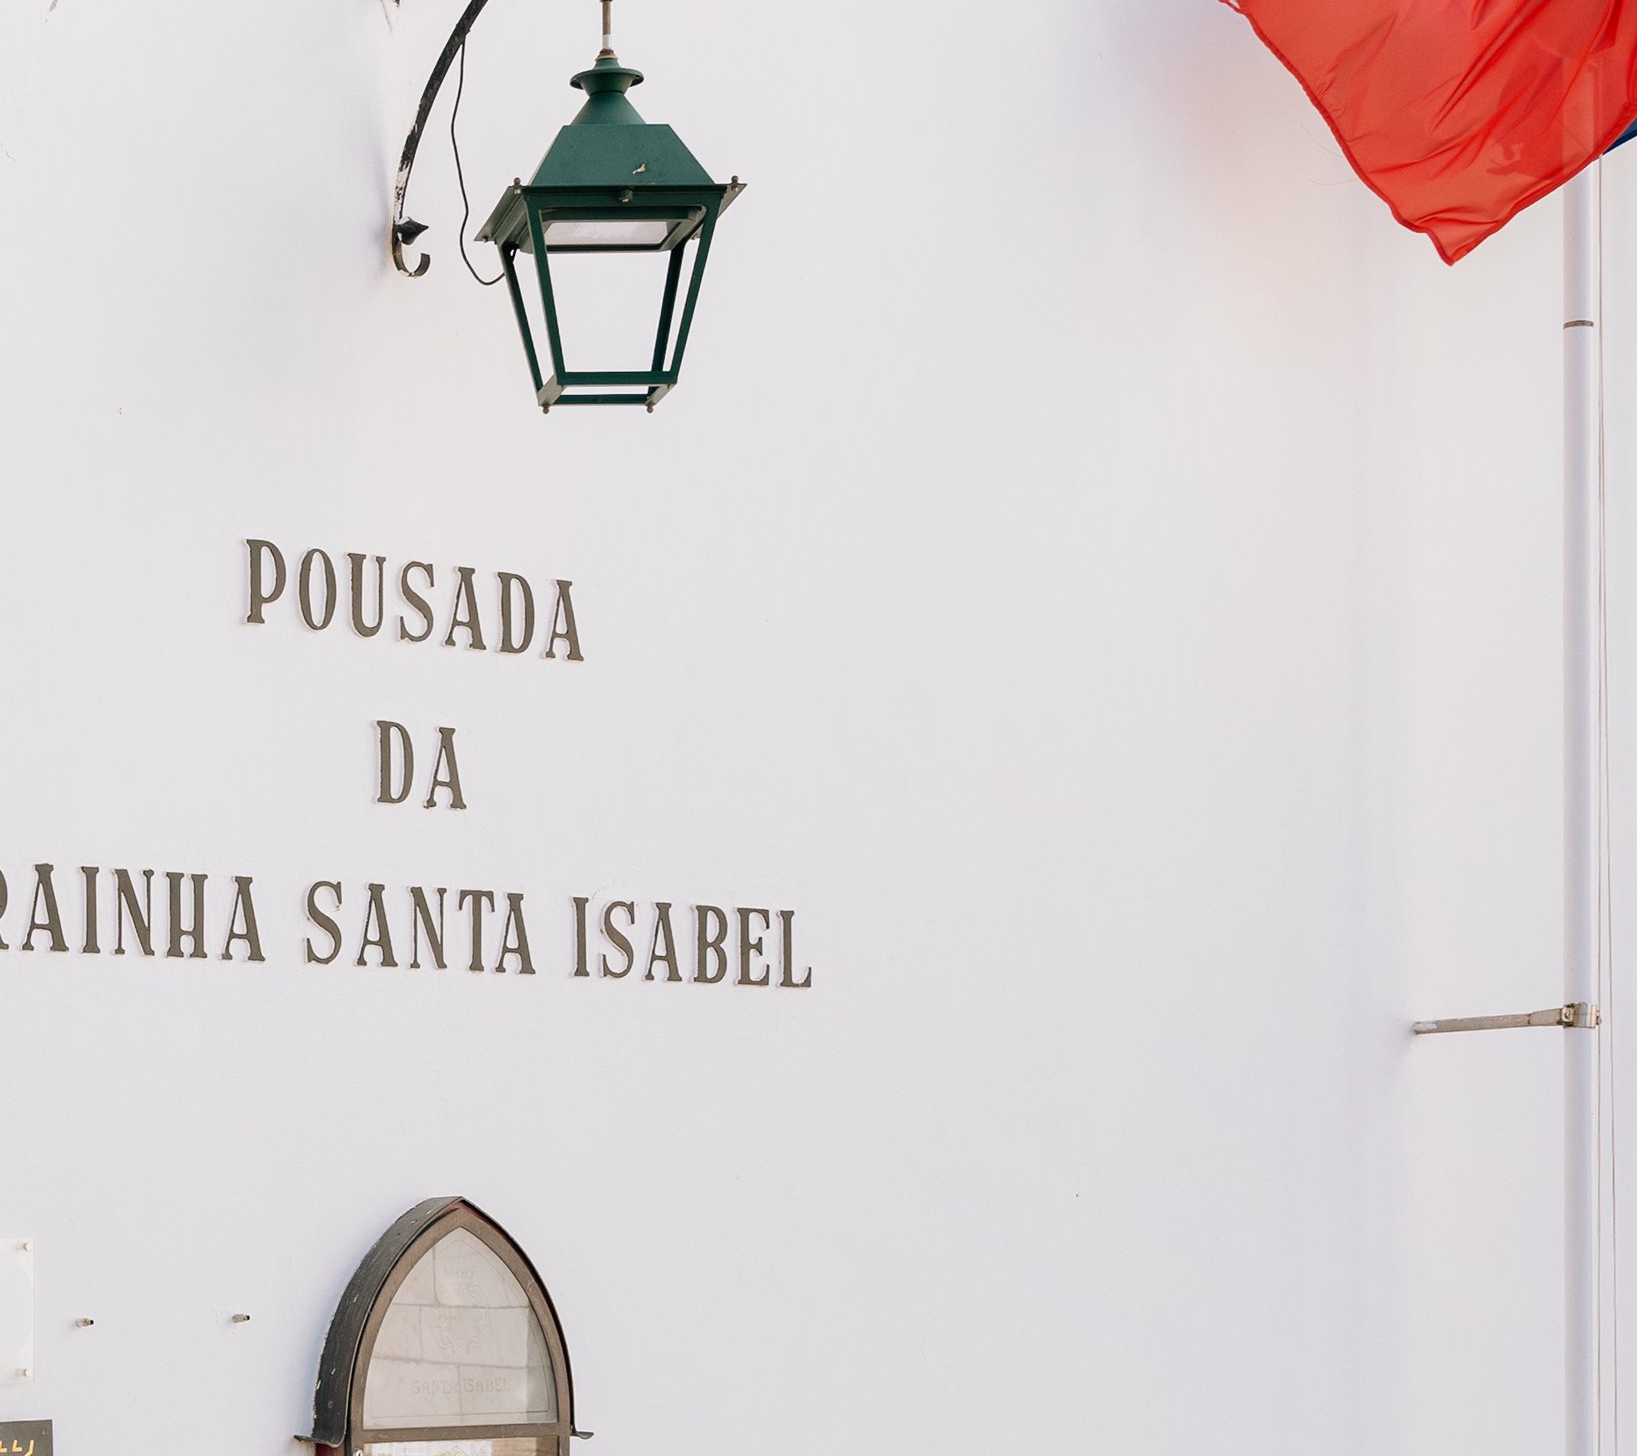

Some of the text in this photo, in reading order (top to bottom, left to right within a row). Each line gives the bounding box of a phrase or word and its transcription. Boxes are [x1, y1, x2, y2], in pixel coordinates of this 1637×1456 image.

[246, 539, 584, 661] POUSADA
[377, 720, 466, 810] DA
[307, 881, 536, 974] SANTA
[573, 897, 812, 988] ISABEL
